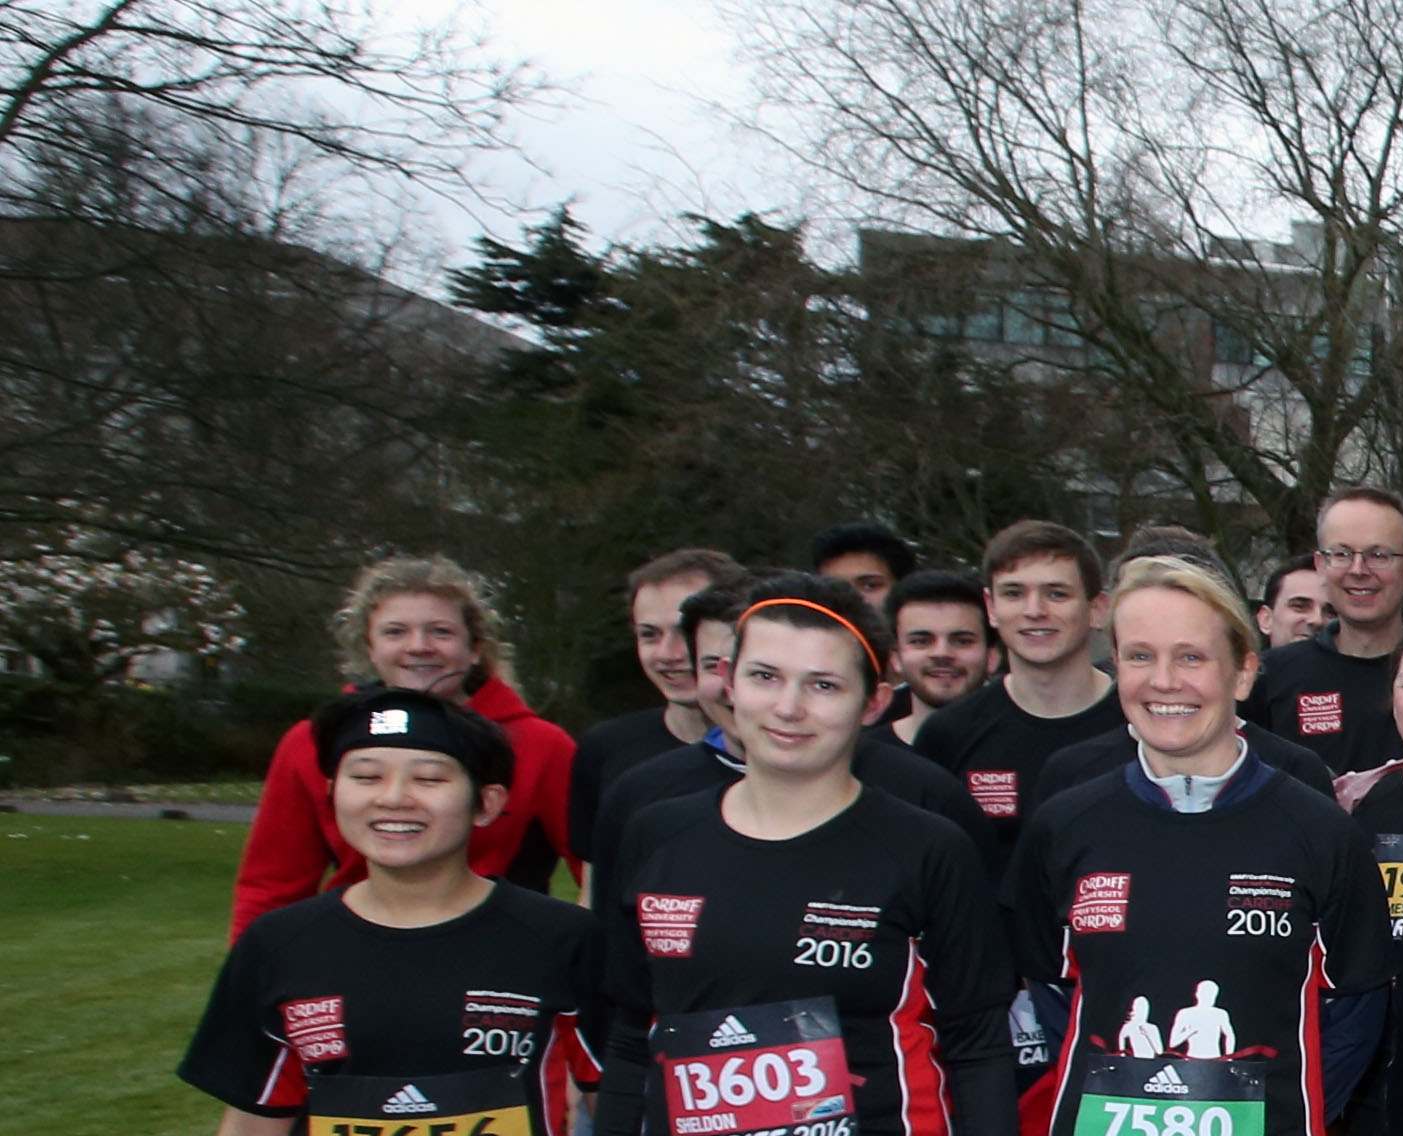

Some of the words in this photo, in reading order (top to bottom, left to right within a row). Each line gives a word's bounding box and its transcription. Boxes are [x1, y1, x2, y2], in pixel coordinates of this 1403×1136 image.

[1226, 909, 1292, 937] 2016
[793, 937, 873, 969] 2016
[463, 1027, 536, 1057] 2016
[709, 1032, 757, 1048] adidas
[673, 1047, 827, 1112] 13603
[1143, 1082, 1189, 1094] adidas
[381, 1102, 439, 1114] adidas
[675, 1112, 738, 1134] SHELDON
